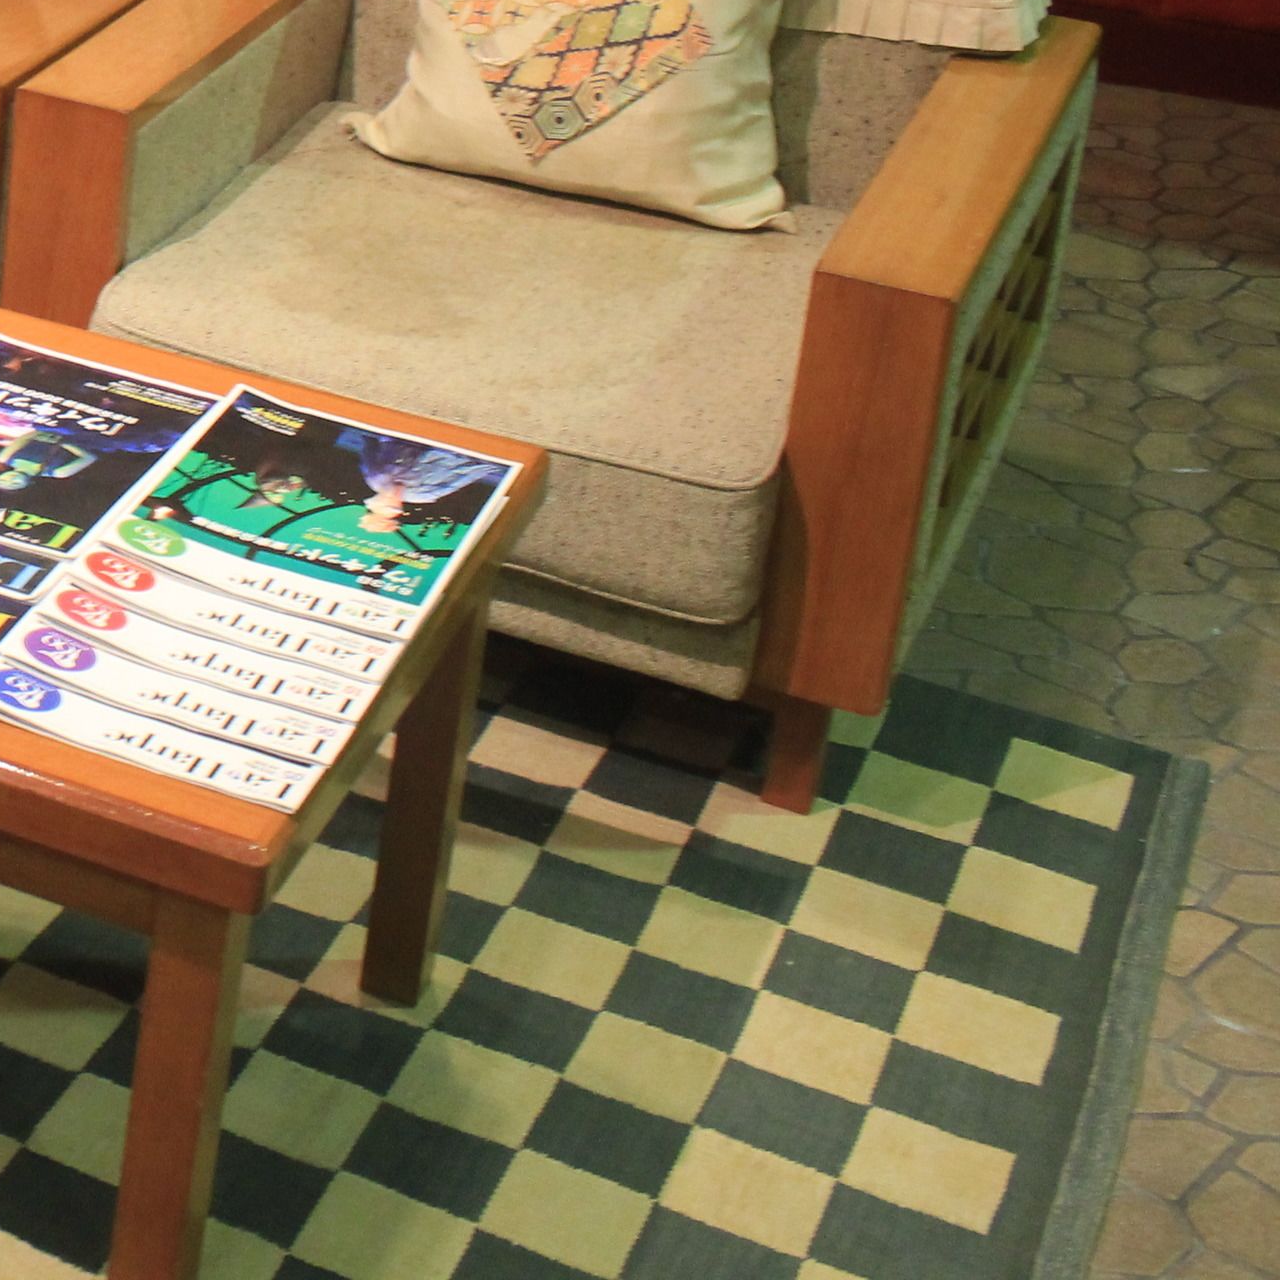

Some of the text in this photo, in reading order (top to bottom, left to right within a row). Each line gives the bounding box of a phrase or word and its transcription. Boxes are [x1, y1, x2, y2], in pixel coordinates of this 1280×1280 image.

[0, 508, 82, 549] La
[229, 576, 341, 616] Harpe
[195, 611, 311, 653] Harpe
[358, 609, 406, 632] La
[168, 650, 287, 695] Harpe
[325, 647, 377, 672] La
[137, 689, 258, 736] Harpe
[300, 687, 354, 714] La
[103, 731, 224, 779] Harpe
[272, 727, 327, 755] La
[239, 771, 294, 800] La
